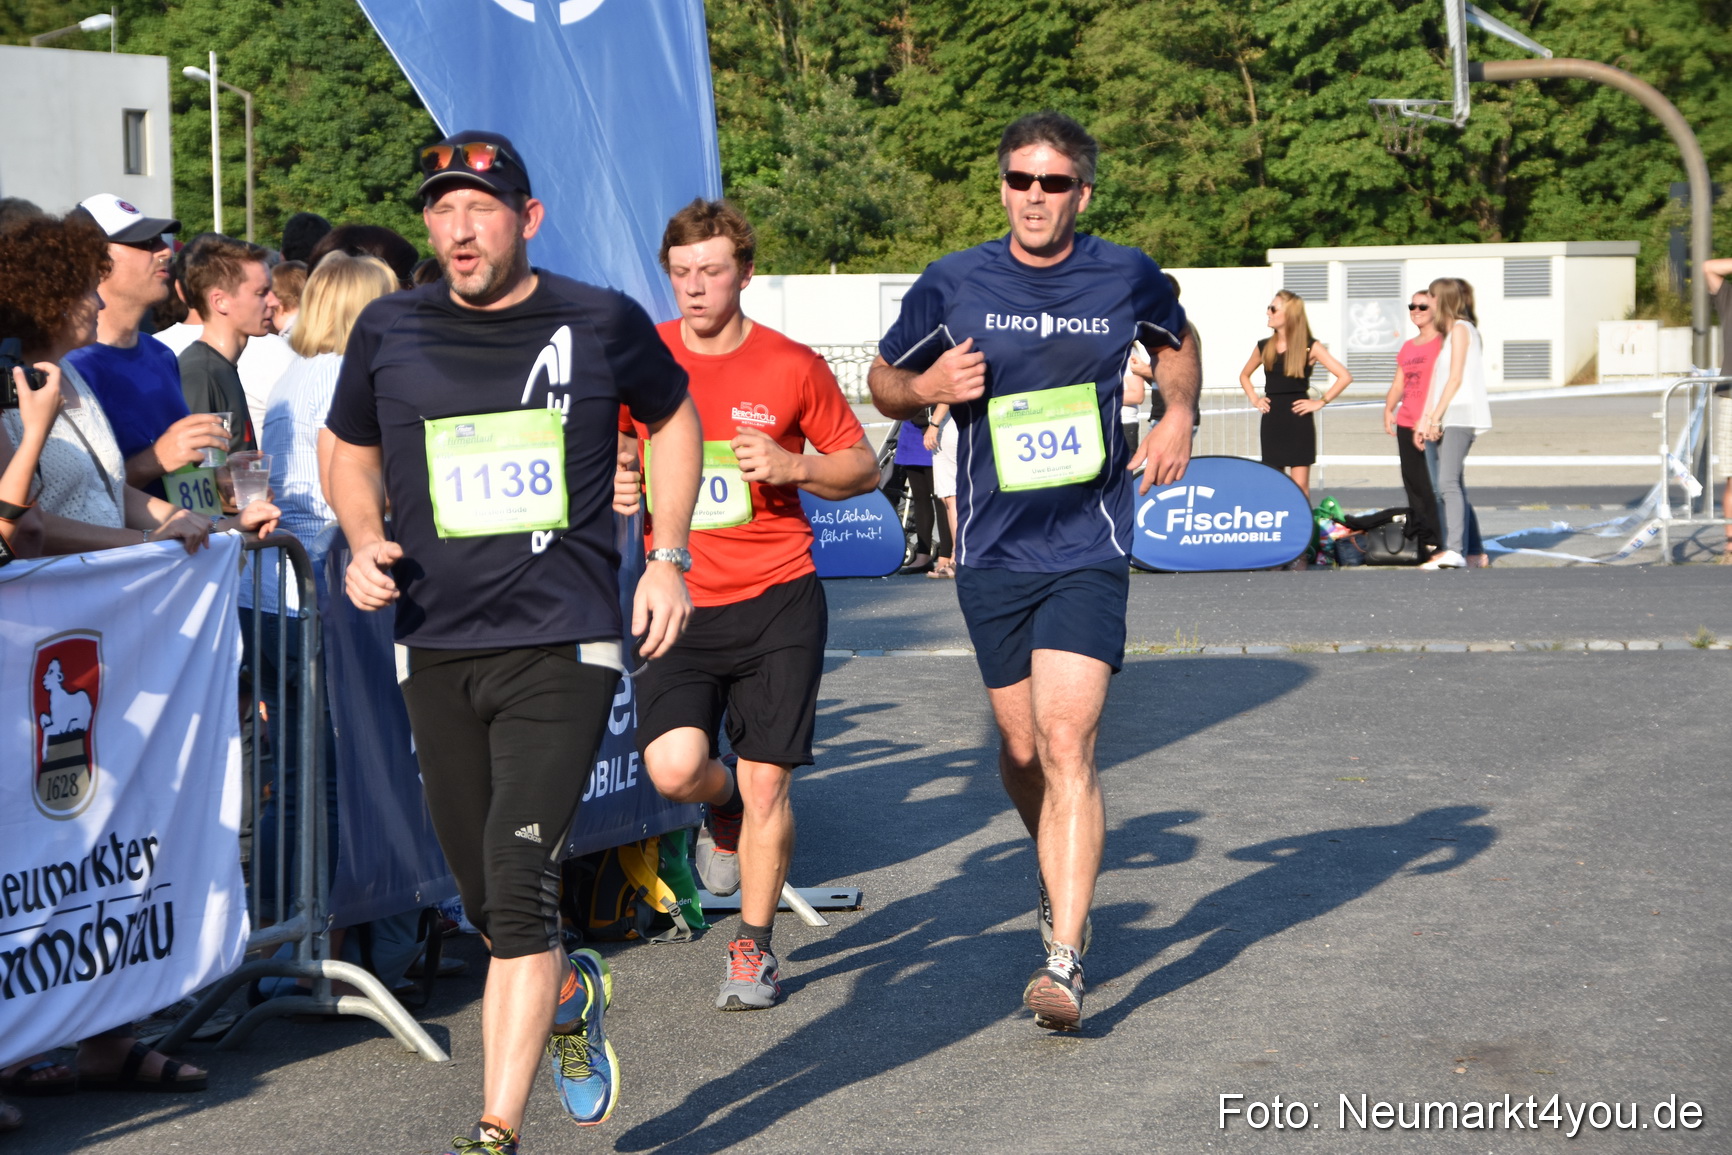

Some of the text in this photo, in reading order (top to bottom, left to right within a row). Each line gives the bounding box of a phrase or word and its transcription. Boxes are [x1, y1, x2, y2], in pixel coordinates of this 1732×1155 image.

[985, 313, 1110, 334] EURO POLES
[1016, 425, 1082, 462] 394
[445, 459, 553, 502] 1138
[179, 477, 213, 511] 816
[811, 508, 883, 524] das Lächeln
[1166, 505, 1289, 532] Fischer
[819, 526, 882, 549] fährt mit!
[1179, 531, 1282, 546] AUTOMOBILE
[45, 772, 79, 802] 1628
[514, 830, 542, 843] adidas
